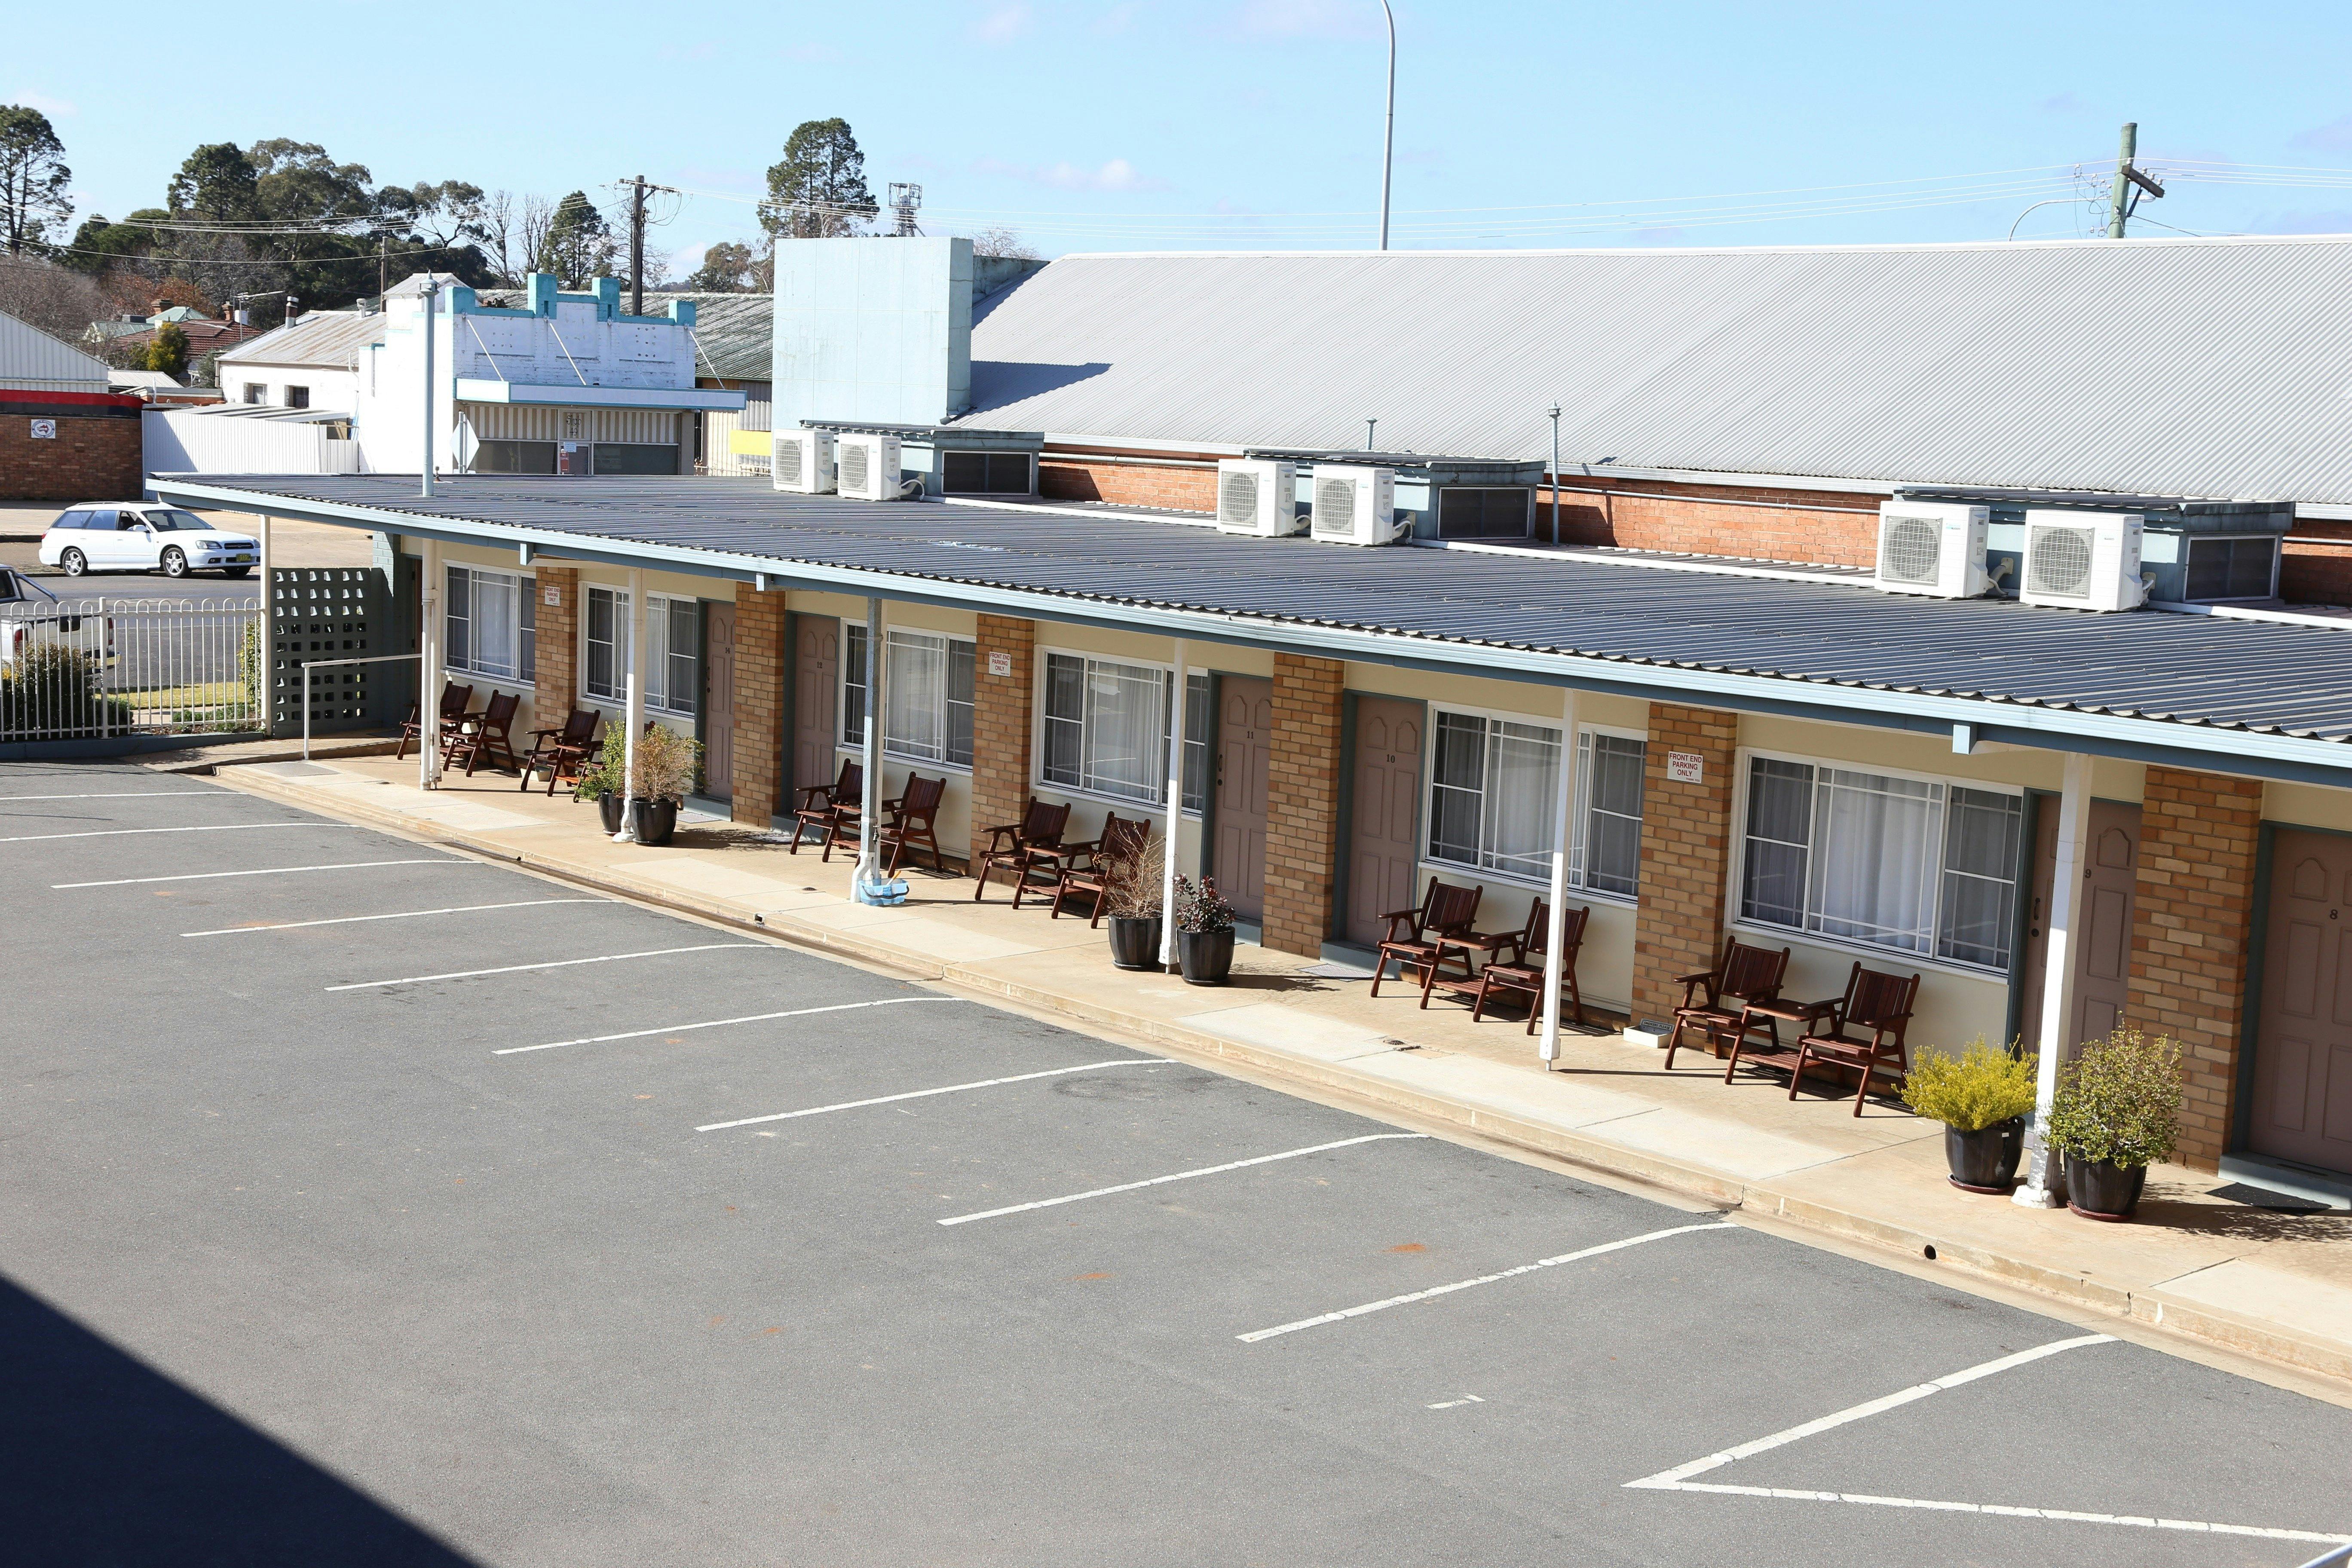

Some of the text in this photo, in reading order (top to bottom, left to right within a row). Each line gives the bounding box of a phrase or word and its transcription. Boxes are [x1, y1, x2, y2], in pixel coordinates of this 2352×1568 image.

[1247, 731, 1253, 739] 11
[1387, 754, 1395, 763] 10
[1672, 761, 1698, 770] PARKING
[2085, 869, 2092, 879] 9
[2330, 909, 2338, 919] 8
